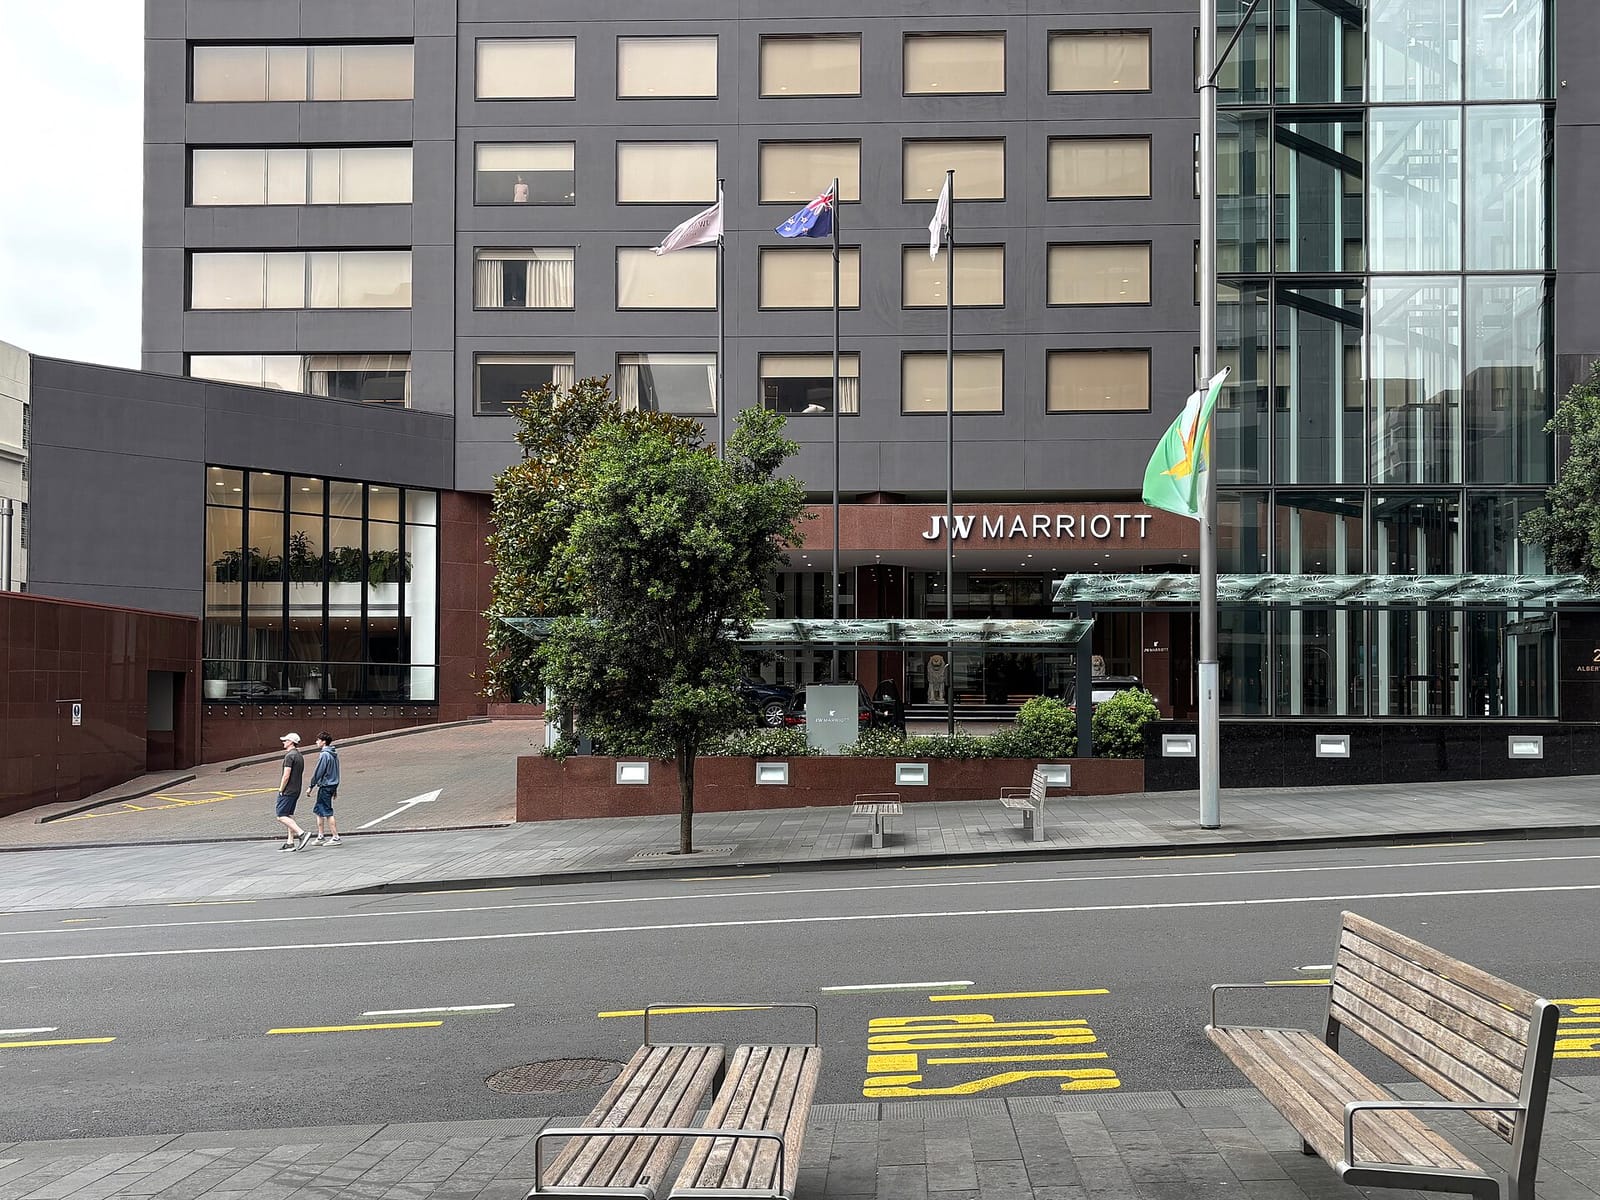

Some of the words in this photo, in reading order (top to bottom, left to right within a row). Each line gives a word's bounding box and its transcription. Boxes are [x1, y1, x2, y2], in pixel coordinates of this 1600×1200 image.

[922, 515, 976, 539] JW
[982, 514, 1152, 538] MARRIOTT
[862, 1013, 1121, 1098] STOP
